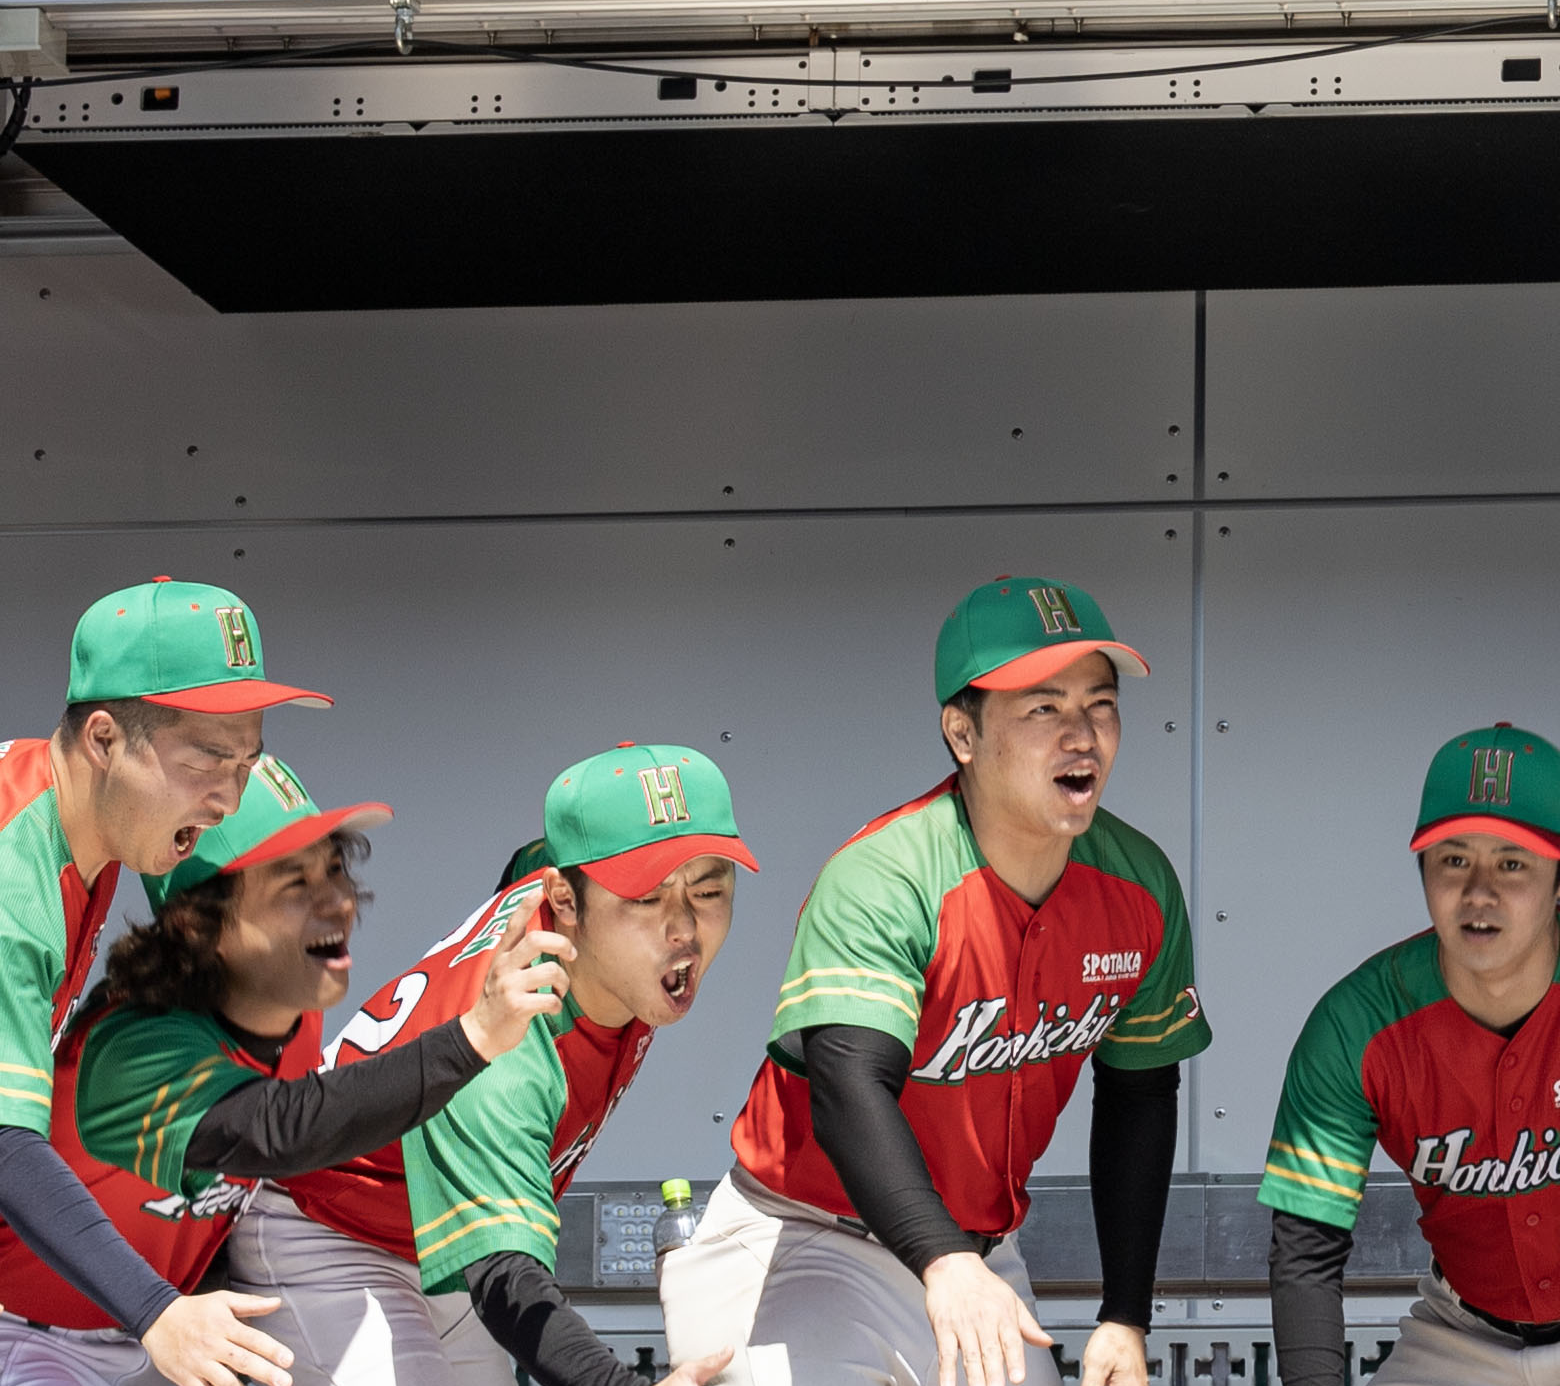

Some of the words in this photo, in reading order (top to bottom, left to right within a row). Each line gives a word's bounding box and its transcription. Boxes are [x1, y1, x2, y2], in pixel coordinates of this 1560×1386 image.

[215, 607, 257, 667] H
[1027, 586, 1083, 634] H
[639, 765, 692, 825] H
[1468, 747, 1514, 805] H
[1082, 951, 1142, 977] SPOTAKA
